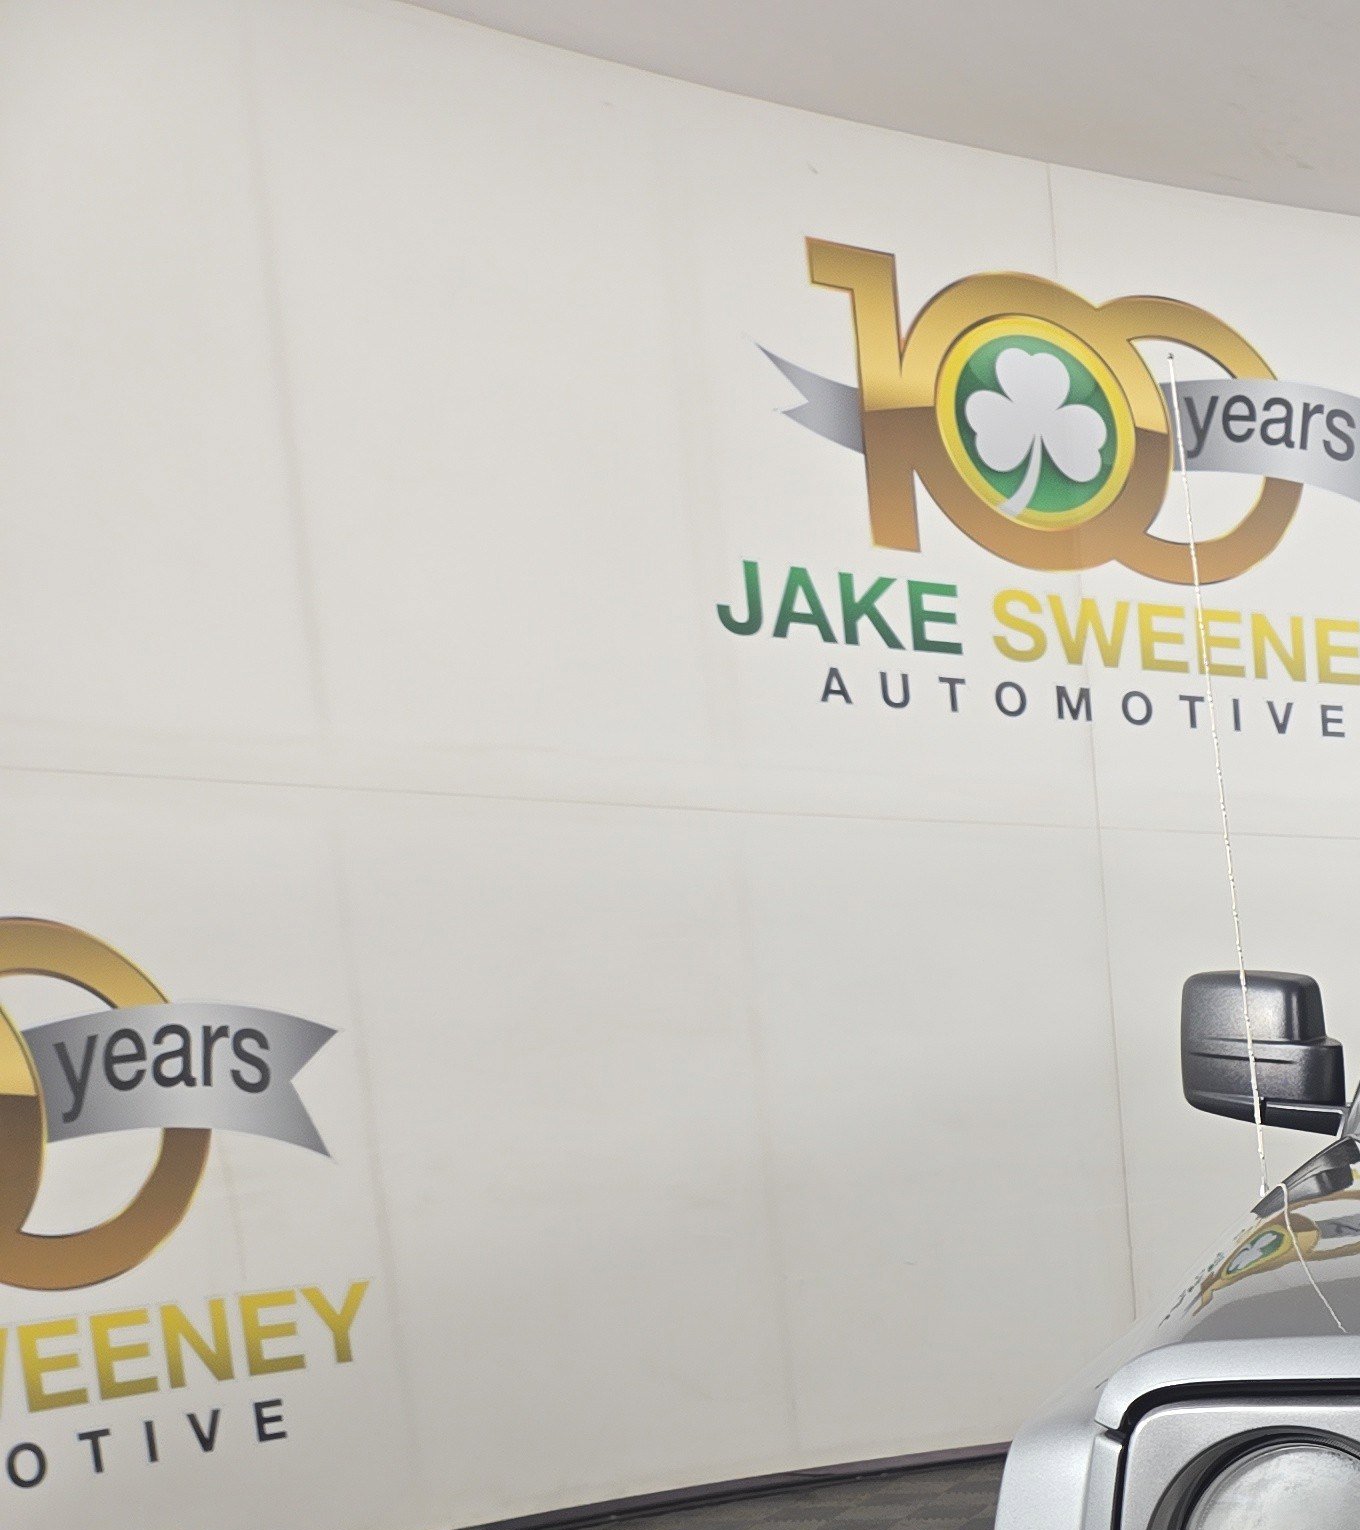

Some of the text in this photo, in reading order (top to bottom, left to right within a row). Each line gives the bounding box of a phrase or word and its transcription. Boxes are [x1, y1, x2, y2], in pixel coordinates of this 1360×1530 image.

[1182, 392, 1359, 462] years
[716, 559, 964, 656] JAKE
[820, 667, 1346, 738] AUTOMOTIVE
[53, 1022, 271, 1124] years
[0, 1280, 370, 1413] EENEY
